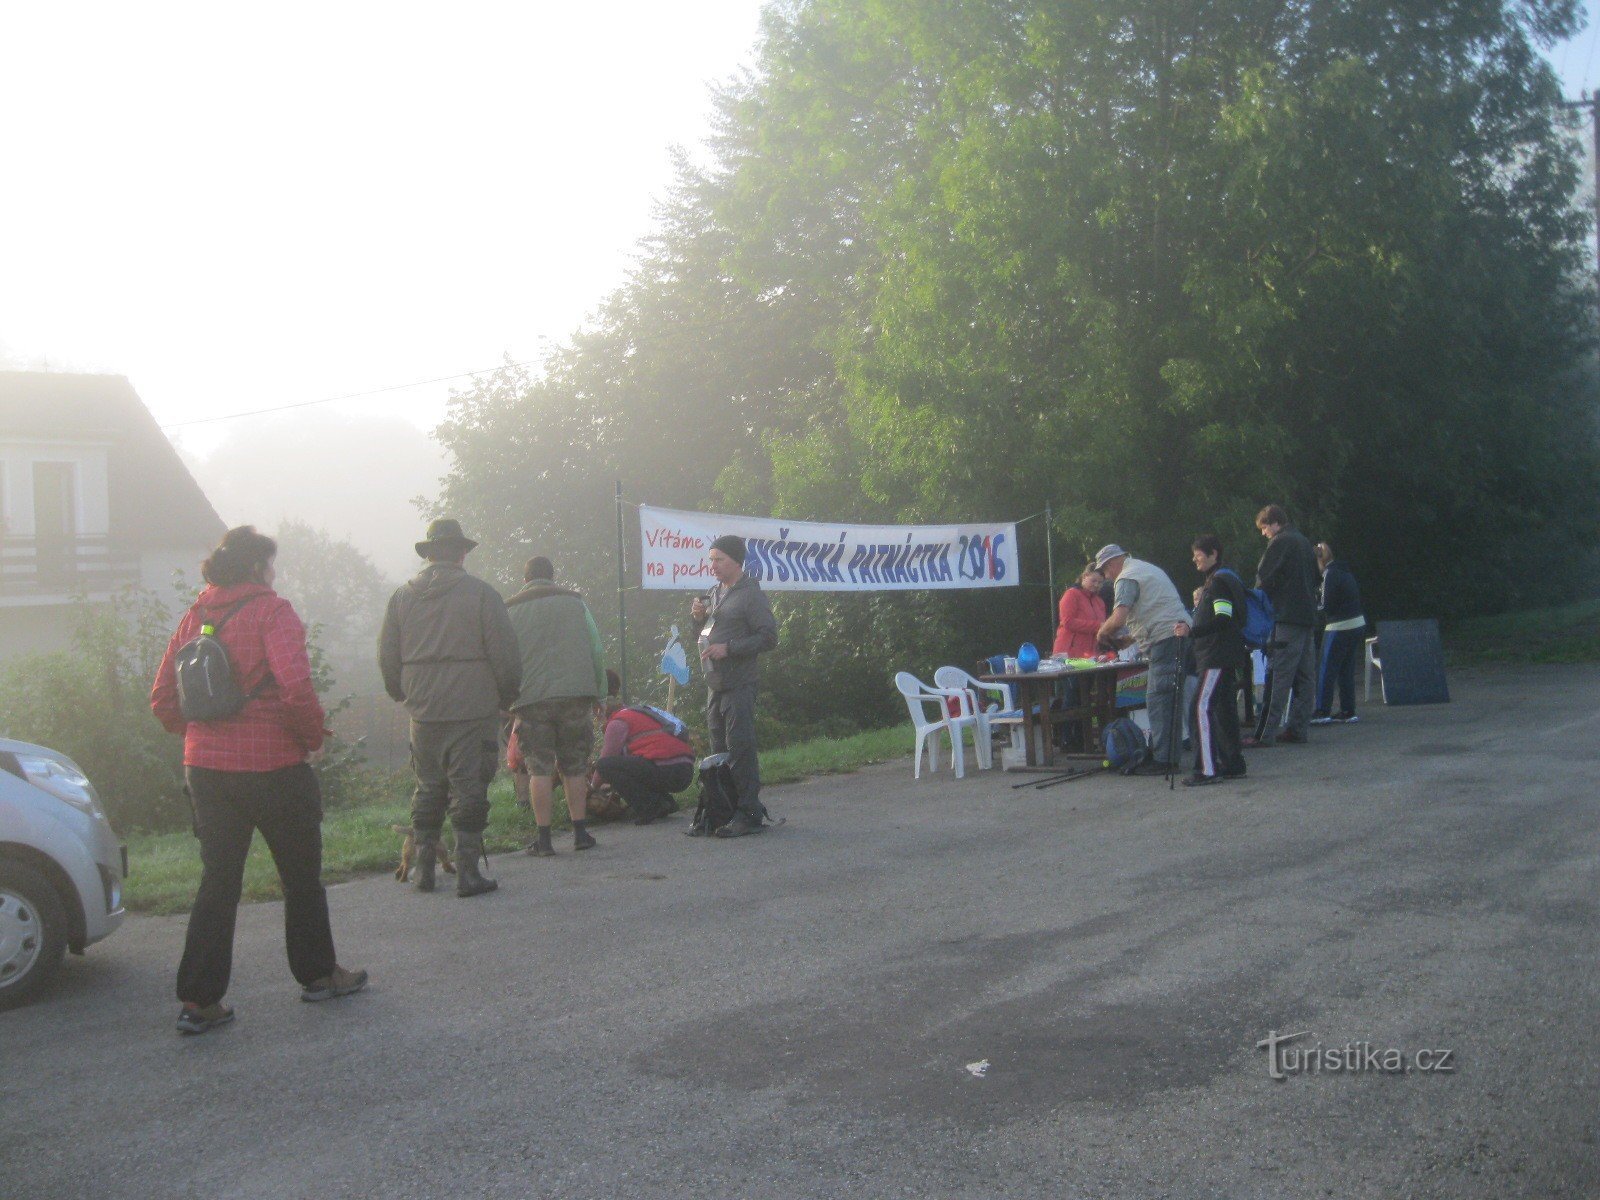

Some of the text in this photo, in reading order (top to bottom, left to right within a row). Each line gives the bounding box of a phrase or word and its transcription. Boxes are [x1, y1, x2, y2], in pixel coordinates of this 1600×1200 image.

[646, 527, 704, 549] Vítáme
[647, 562, 664, 576] na
[847, 532, 953, 584] PATNÁCTKA
[959, 533, 1006, 581] 2016
